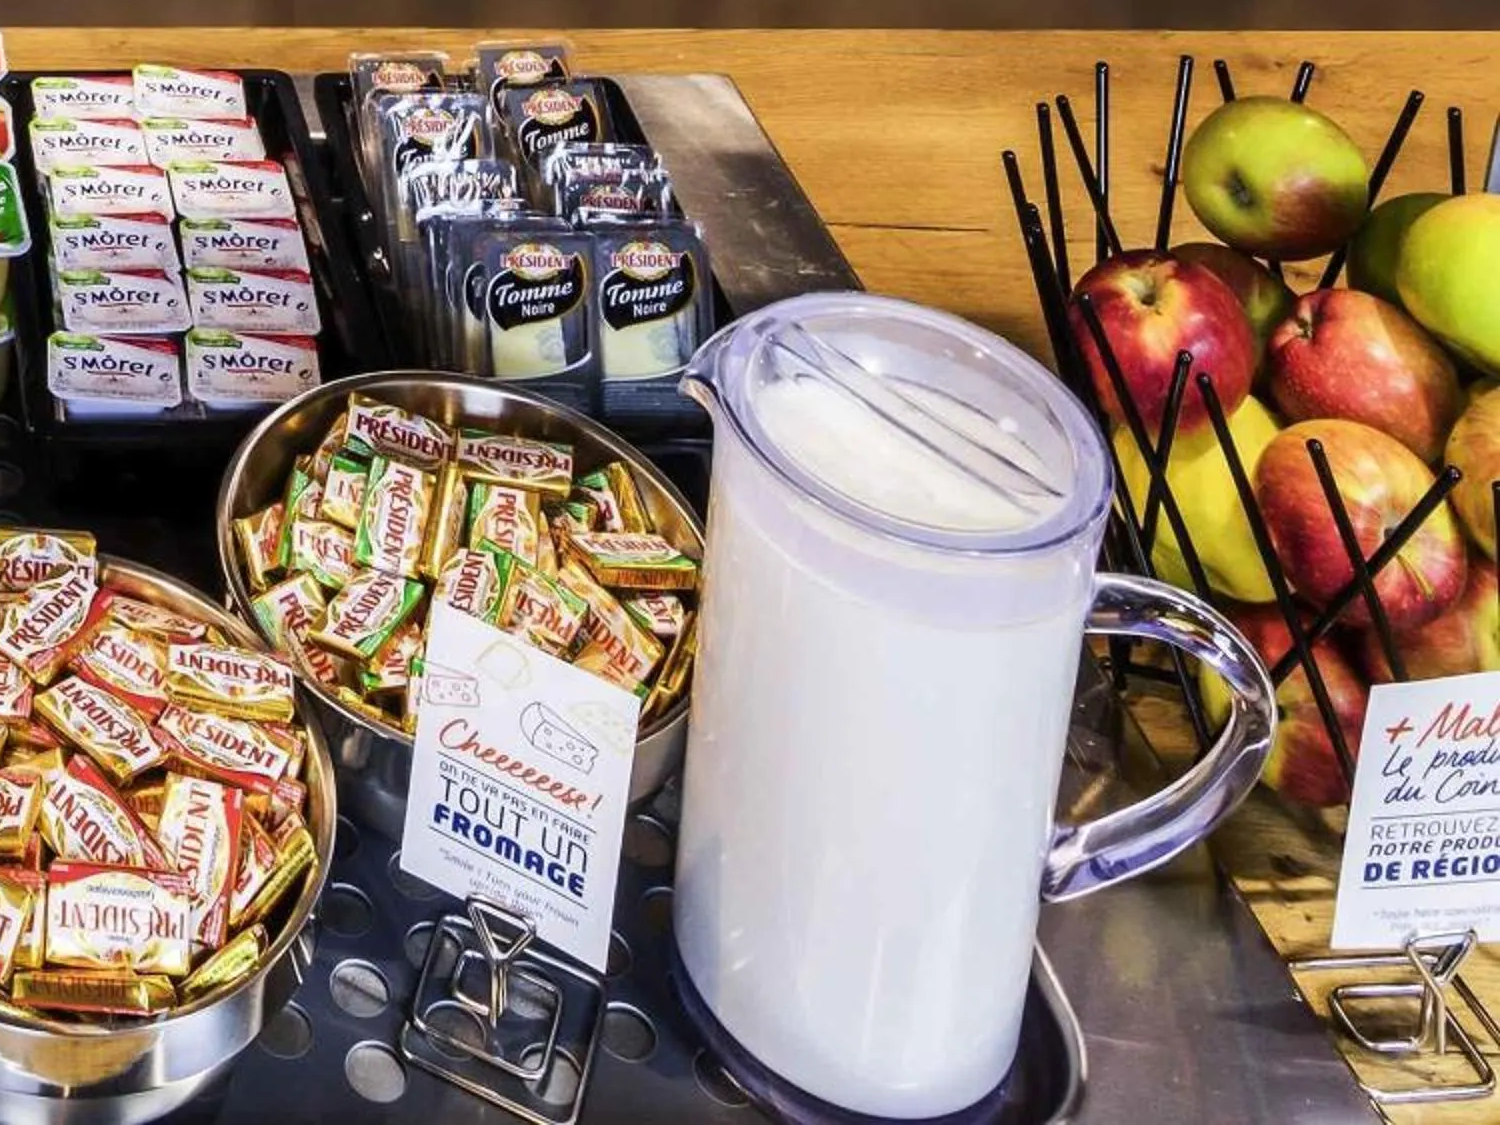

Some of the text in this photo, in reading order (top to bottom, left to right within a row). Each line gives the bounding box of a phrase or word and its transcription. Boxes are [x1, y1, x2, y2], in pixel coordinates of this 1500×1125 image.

[525, 123, 590, 152] Tomme
[503, 253, 574, 268] PRÉSIDENT
[612, 252, 682, 268] PRÉSIDENT
[496, 281, 573, 306] Tomme
[522, 303, 555, 318] Noire
[607, 279, 684, 306] Tomme
[633, 302, 667, 318] Noire
[356, 412, 454, 461] PRÉSIDENT
[465, 443, 571, 471] PRÉSIDENT
[497, 492, 517, 550] PRÉSI
[448, 551, 486, 611] ÉSIDENT
[6, 576, 89, 651] PRÉSIDENT
[94, 634, 166, 689] ÉSIDEN
[176, 651, 291, 688] PRÉSIDENT
[58, 681, 151, 759] PRÉSIDENT
[164, 705, 279, 769] PRÉSIDENT
[1382, 744, 1413, 777] Le
[439, 760, 590, 845] ON NE VA PAS EN FAIRE
[1384, 777, 1426, 804] du
[50, 783, 130, 865] SIDENT
[178, 782, 213, 879] SIDENT
[440, 774, 587, 874] TOUT UN
[1370, 816, 1498, 841] RETROUVEZ
[433, 802, 586, 898] FROMAGE
[1368, 841, 1433, 857] NOTRE
[1363, 860, 1402, 882] DE
[59, 899, 186, 940] PRÉSIDENT
